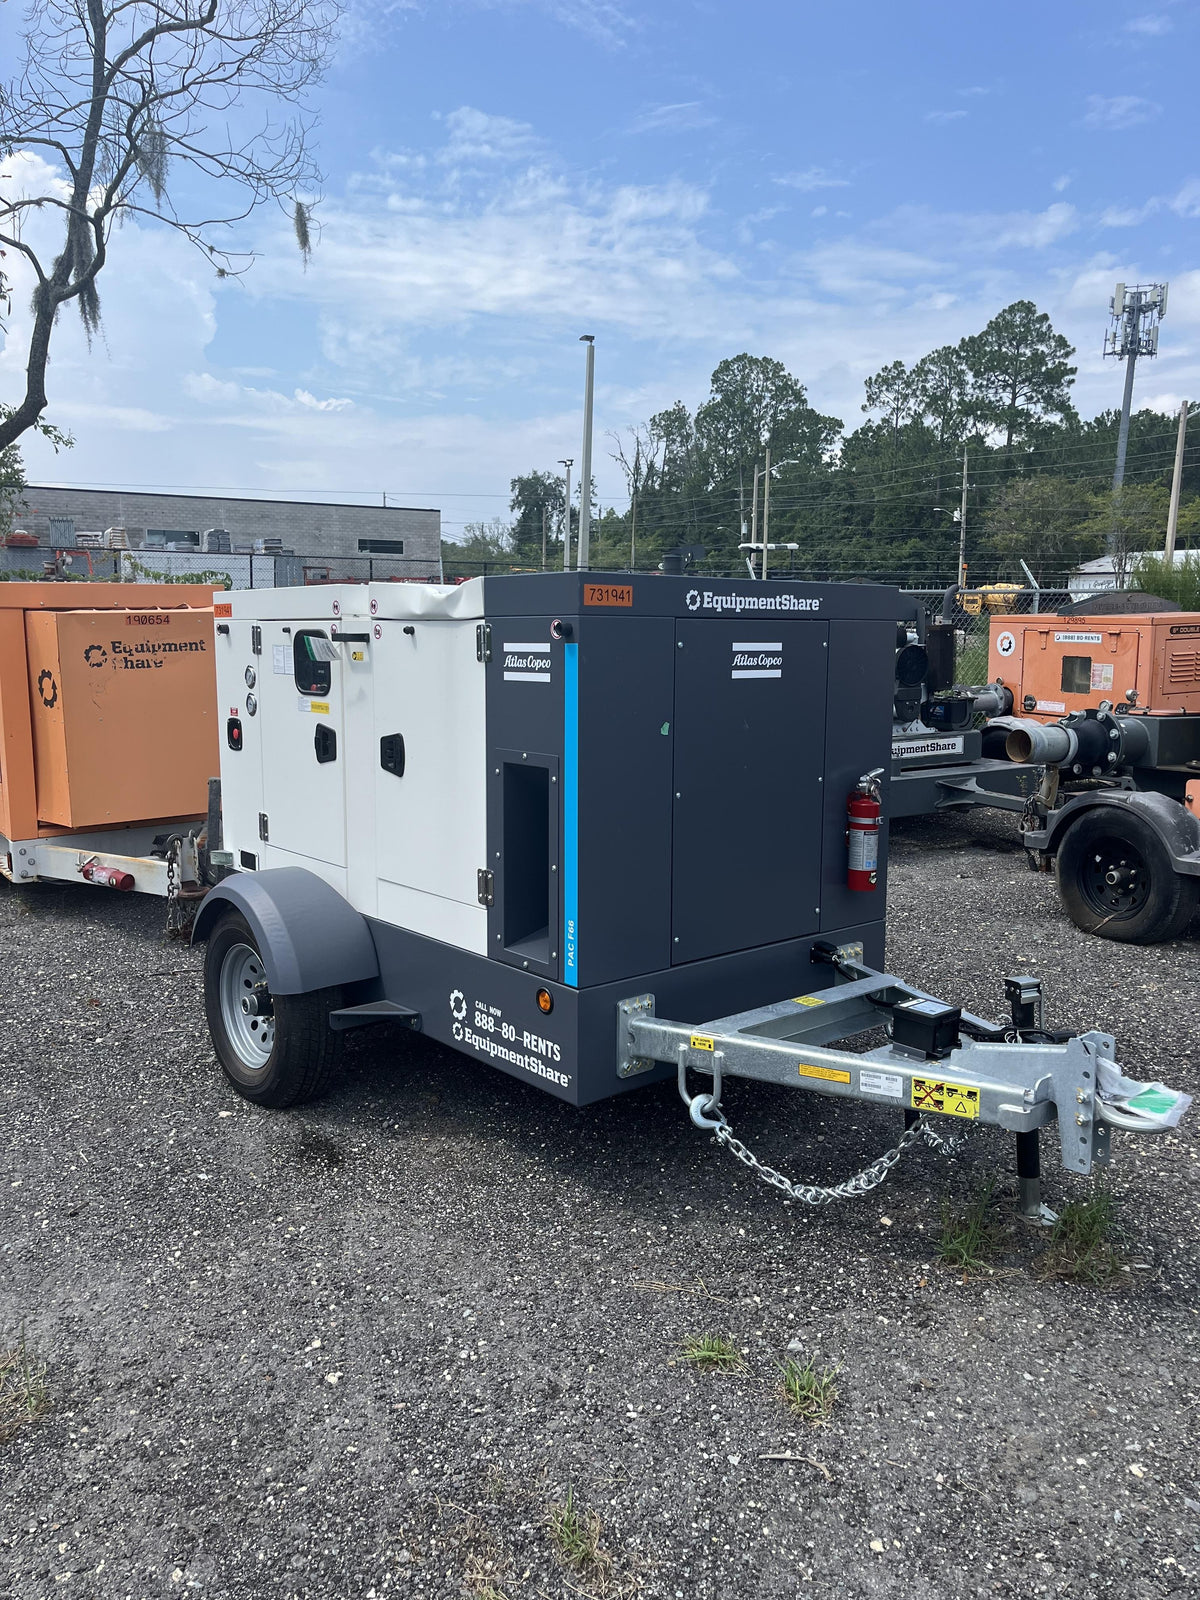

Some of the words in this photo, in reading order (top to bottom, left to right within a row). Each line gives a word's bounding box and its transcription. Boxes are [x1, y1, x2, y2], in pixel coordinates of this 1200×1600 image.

[588, 587, 632, 604] 731941
[702, 591, 821, 612] EquipmentShare
[126, 615, 171, 625] 190654
[111, 639, 207, 657] Equipment
[503, 654, 527, 668] Atlas
[528, 655, 551, 671] Copco
[732, 653, 757, 667] Atlas
[758, 654, 783, 668] Copco
[567, 920, 576, 942] F66
[567, 944, 576, 968] PAC
[474, 1000, 488, 1013] CALL
[489, 1006, 503, 1018] NOW
[464, 1027, 570, 1088] EquipmentShare
